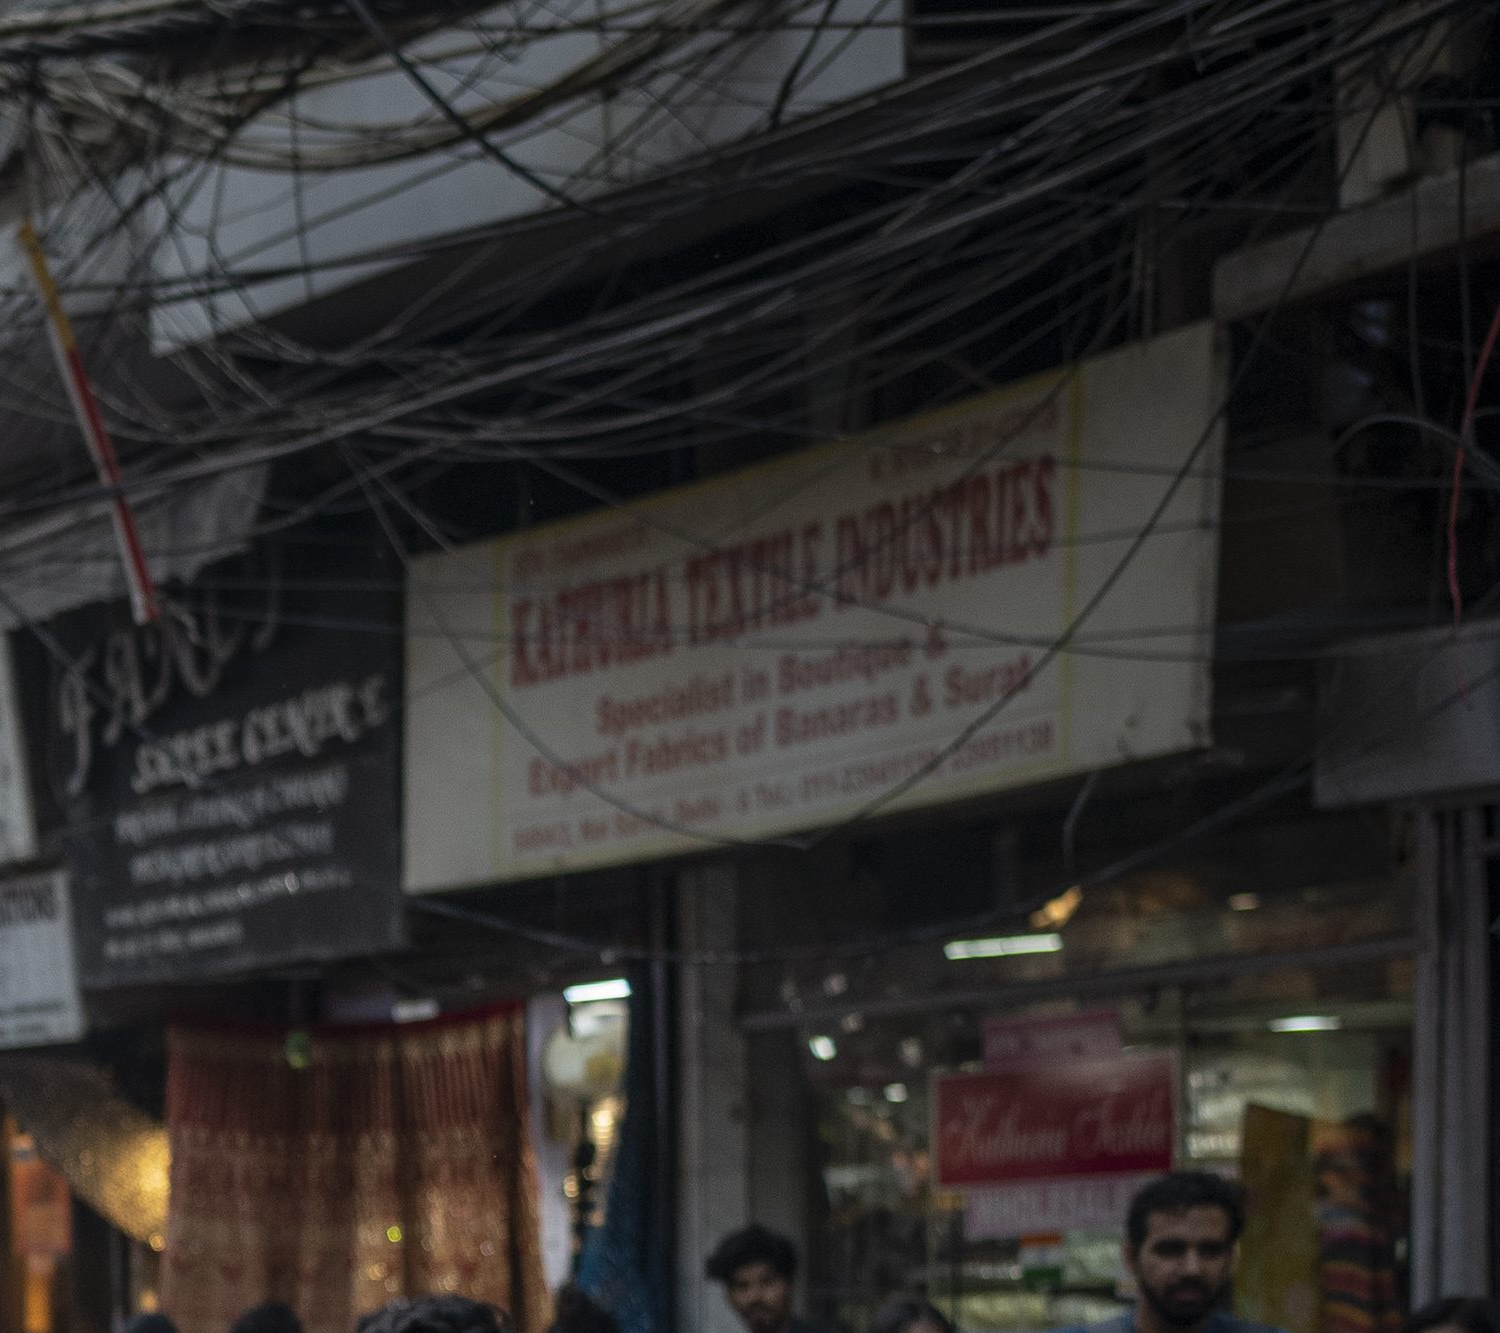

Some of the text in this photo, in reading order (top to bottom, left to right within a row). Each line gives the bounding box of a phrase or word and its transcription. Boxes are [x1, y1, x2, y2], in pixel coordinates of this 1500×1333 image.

[685, 520, 822, 647] TEXTILE
[832, 454, 1057, 610] INDUSTRIES
[593, 672, 736, 738] Specialist
[740, 662, 770, 705] in
[777, 628, 915, 701] Boutique
[625, 719, 727, 785] Fabrics
[736, 708, 768, 755] of
[775, 683, 900, 754] Banaras
[909, 675, 934, 719] &
[943, 652, 1035, 712] Surat
